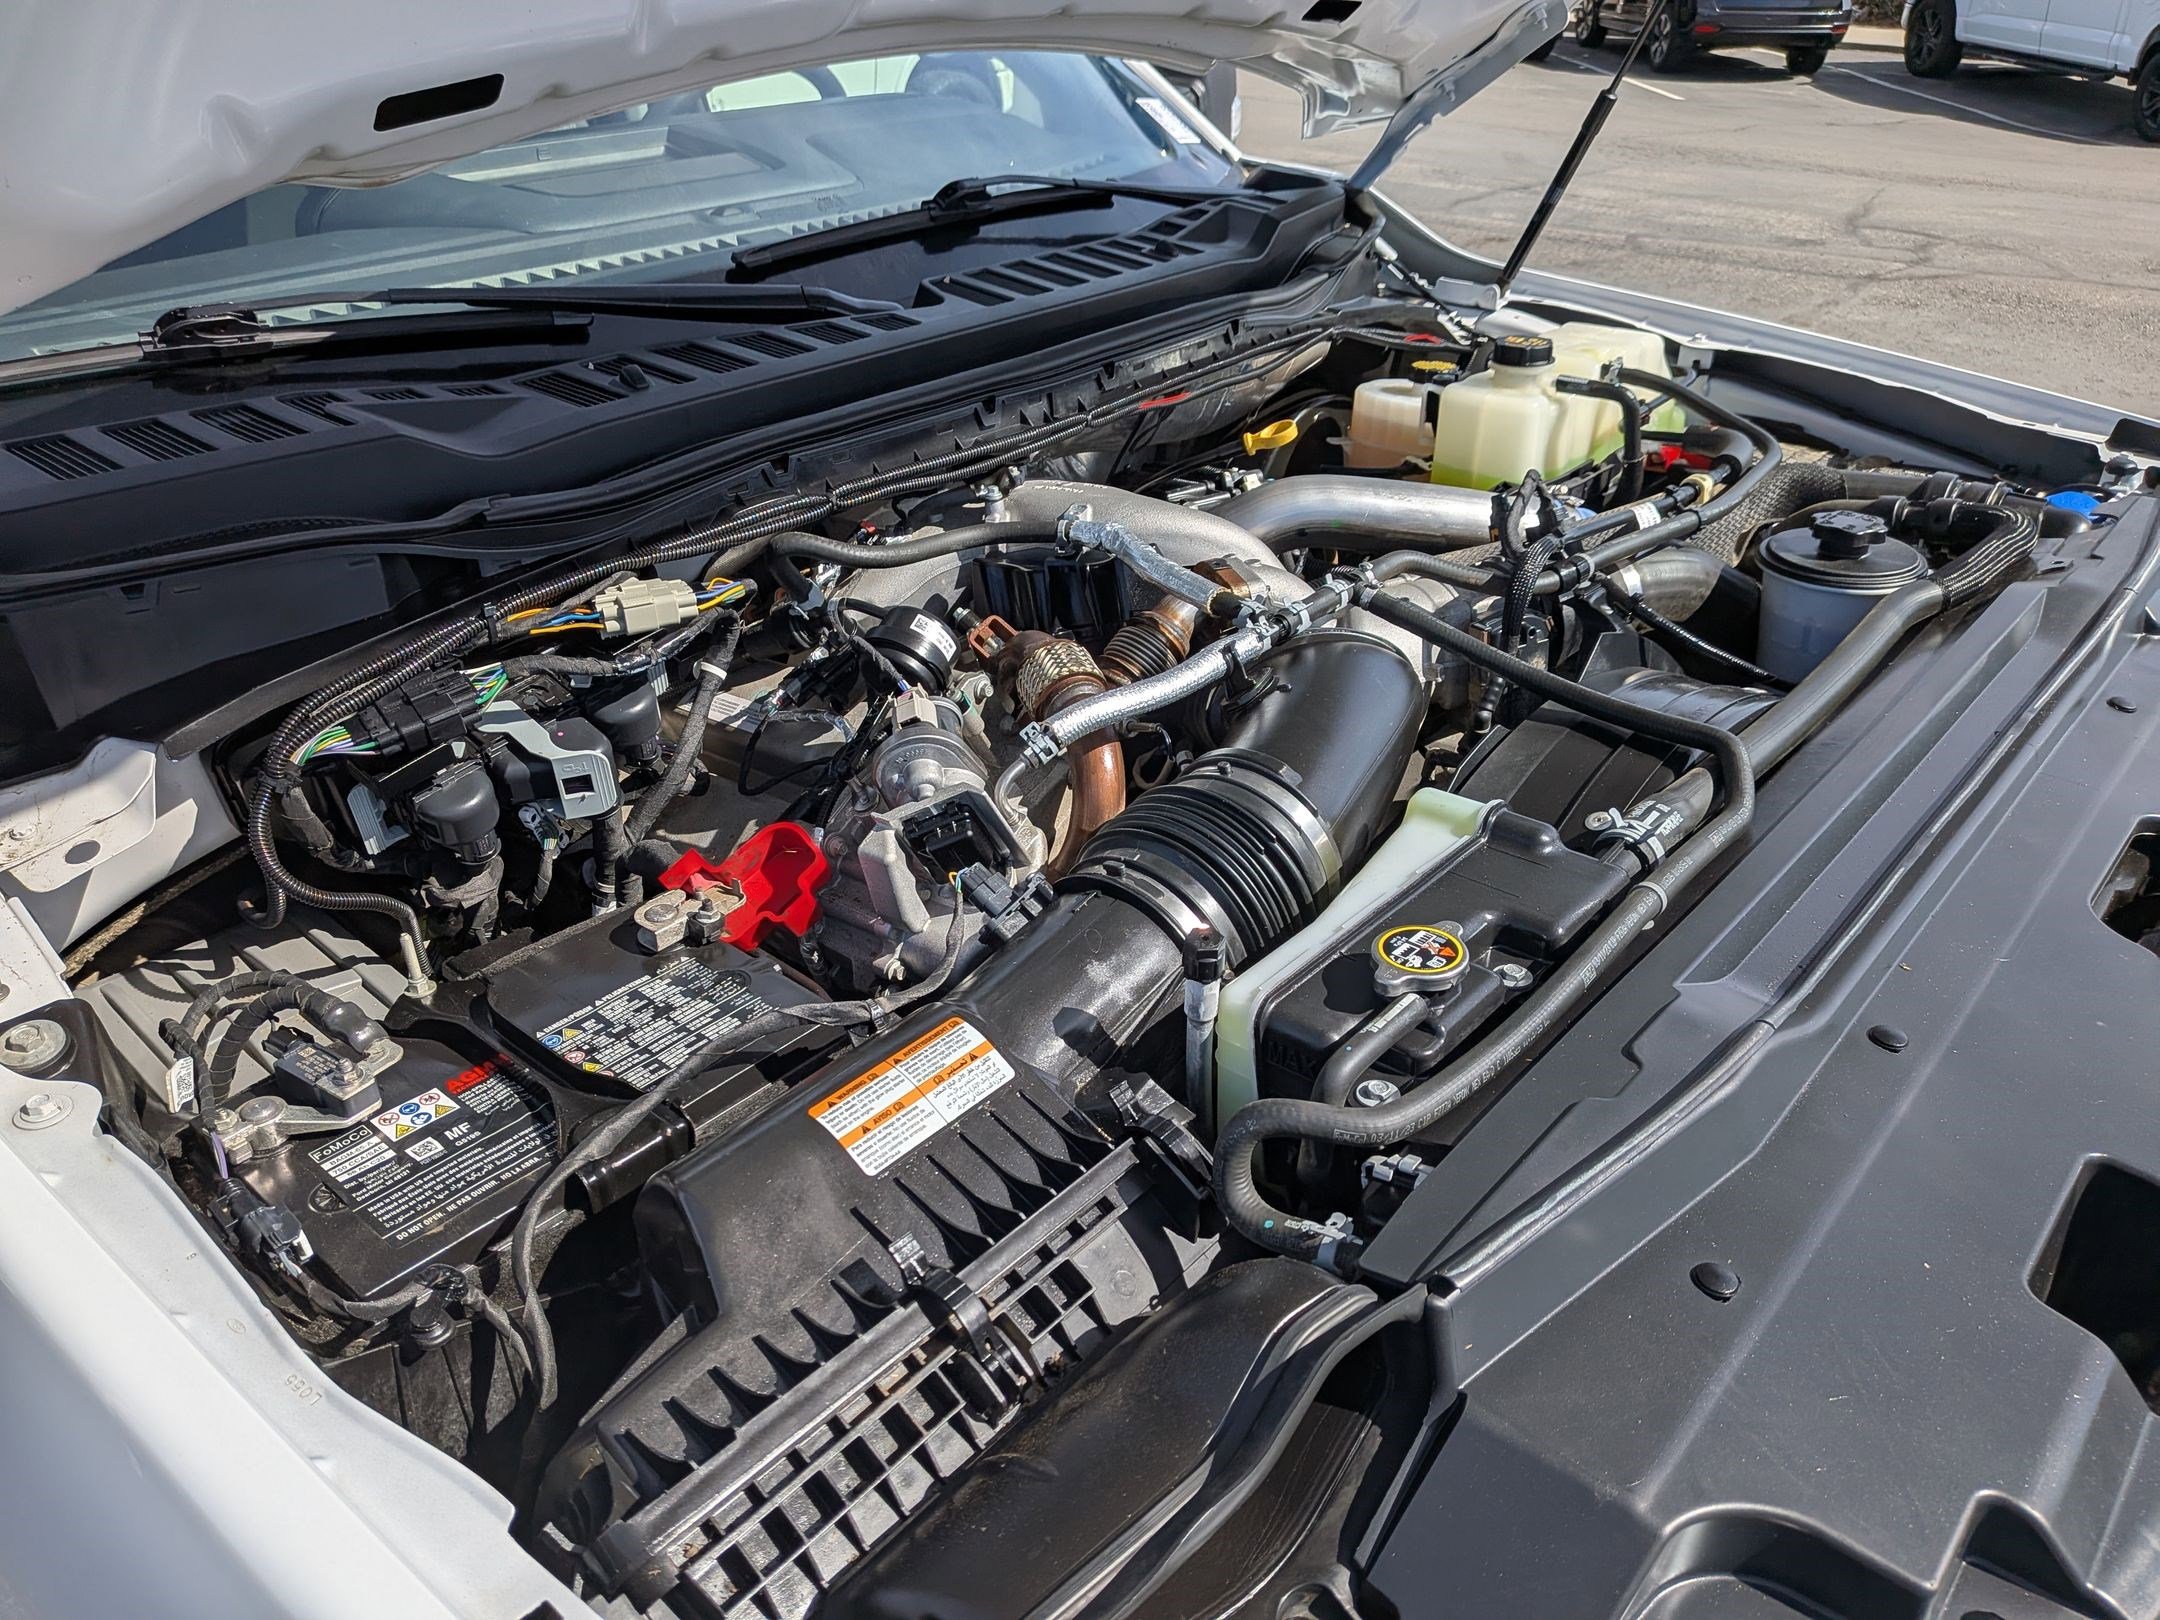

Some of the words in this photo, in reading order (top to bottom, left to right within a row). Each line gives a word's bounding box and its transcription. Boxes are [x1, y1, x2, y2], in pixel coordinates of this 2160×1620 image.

[902, 1025, 948, 1057] AVERTISSEMENT
[835, 1078, 867, 1101] WARNING
[443, 1120, 472, 1141] MF
[871, 1108, 893, 1125] AVISO
[313, 1125, 368, 1161] FoMoCo
[1371, 1121, 1415, 1145] 03/11/23
[332, 1164, 348, 1175] 750
[347, 1143, 384, 1167] CCA/SAE
[343, 1179, 358, 1190] Dist.
[351, 1187, 366, 1197] Ford
[365, 1177, 384, 1189] Motor
[383, 1160, 414, 1180] Company,
[356, 1182, 386, 1202] Dearborn,
[367, 1200, 384, 1212] Made
[389, 1190, 403, 1200] USA
[401, 1183, 414, 1193] with
[413, 1178, 423, 1186] US
[422, 1173, 434, 1181] and
[433, 1159, 458, 1176] imported
[457, 1145, 484, 1163] materials.
[372, 1200, 398, 1218] Fabriqué
[397, 1195, 408, 1203] aux
[435, 1172, 448, 1182] avec
[447, 1166, 459, 1174] des
[395, 1230, 409, 1241] DO
[407, 1222, 423, 1234] NOT
[422, 1209, 445, 1226] OPEN.
[445, 1202, 458, 1212] NE
[456, 1194, 472, 1206] PAS
[470, 1177, 500, 1198] OUVRIR.
[499, 1171, 512, 1181] NO
[510, 1165, 521, 1175] LA
[520, 1154, 542, 1169] ABRA.
